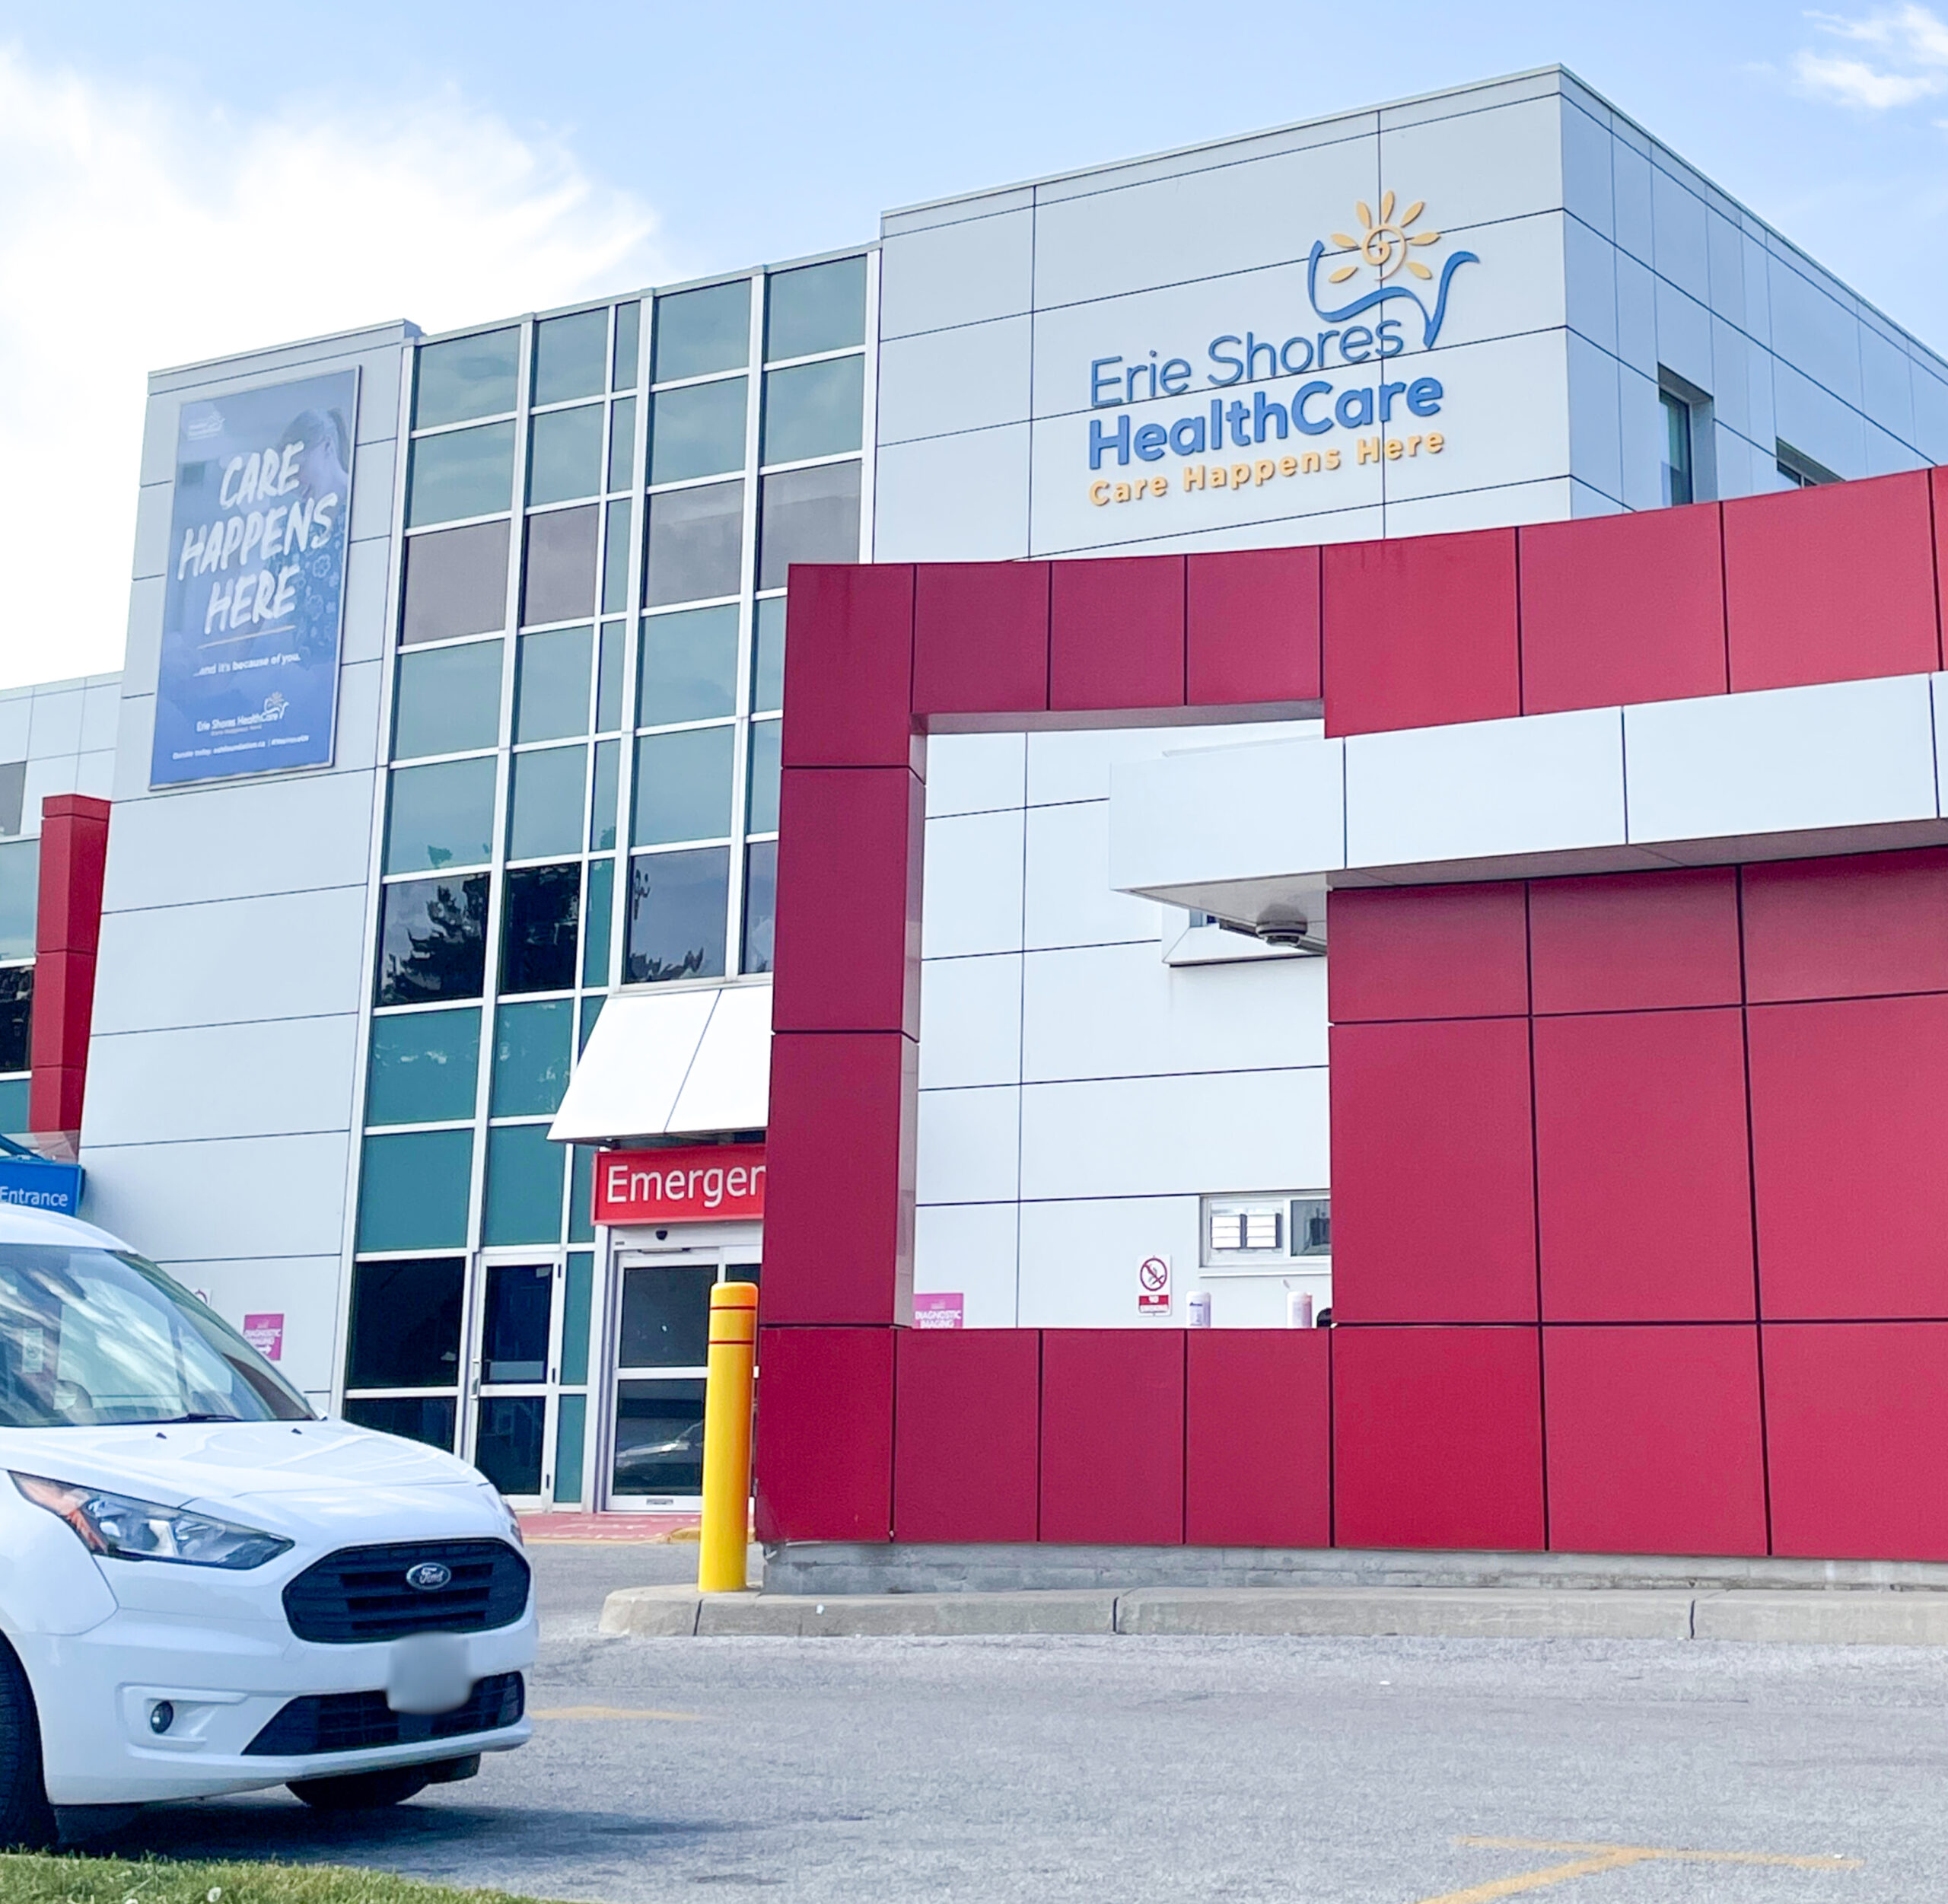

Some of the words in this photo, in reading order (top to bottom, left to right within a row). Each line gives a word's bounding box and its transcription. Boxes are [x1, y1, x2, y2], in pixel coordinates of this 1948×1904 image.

[1091, 350, 1192, 408] Erie
[1208, 320, 1405, 387] Shores
[1088, 377, 1444, 470] HealthCare
[219, 441, 304, 510] CARE
[1088, 475, 1168, 506] Care
[1182, 447, 1342, 492] Happens
[1357, 431, 1445, 465] Here
[177, 492, 338, 581] HAPPENS
[204, 564, 301, 635] HERE
[232, 657, 269, 670] because
[270, 653, 281, 664] of
[0, 1186, 68, 1207] Entrance
[915, 1310, 962, 1320] DIAGNOSTIC
[419, 1567, 444, 1584] Ford
